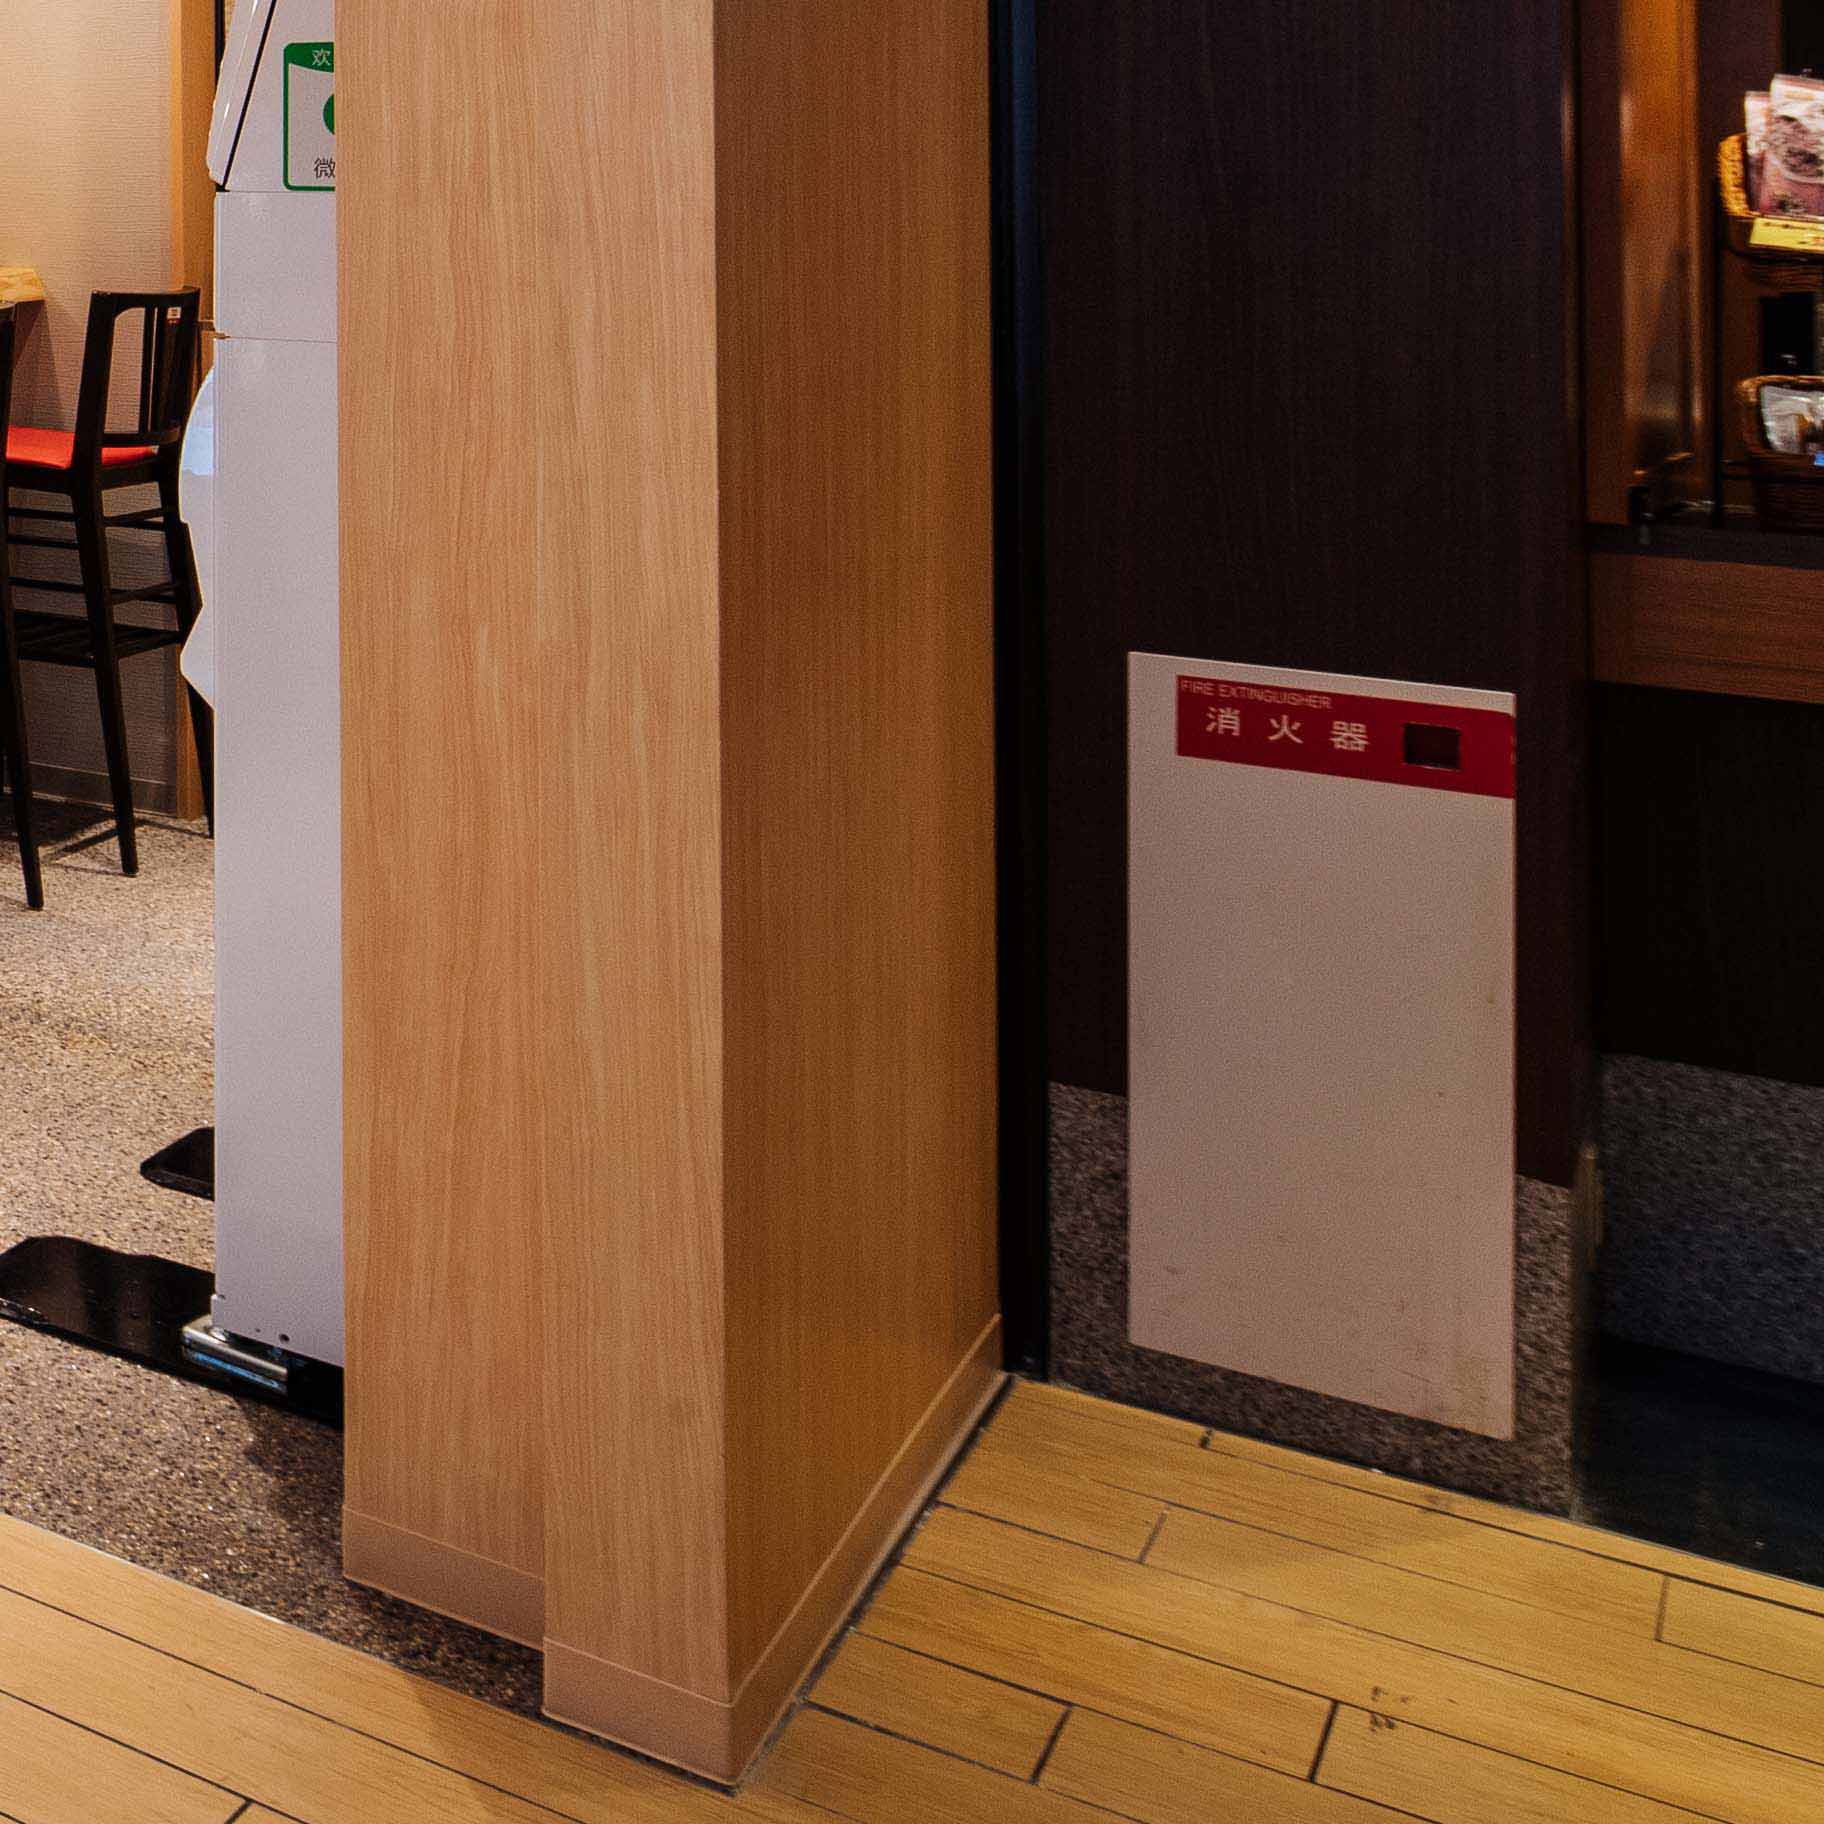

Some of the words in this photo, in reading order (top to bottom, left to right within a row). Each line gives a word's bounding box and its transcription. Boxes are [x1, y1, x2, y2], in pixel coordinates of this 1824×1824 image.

[1181, 679, 1215, 697] FIRE
[1218, 683, 1333, 710] EXTINGUISHER
[1205, 706, 1370, 753] 消火器
